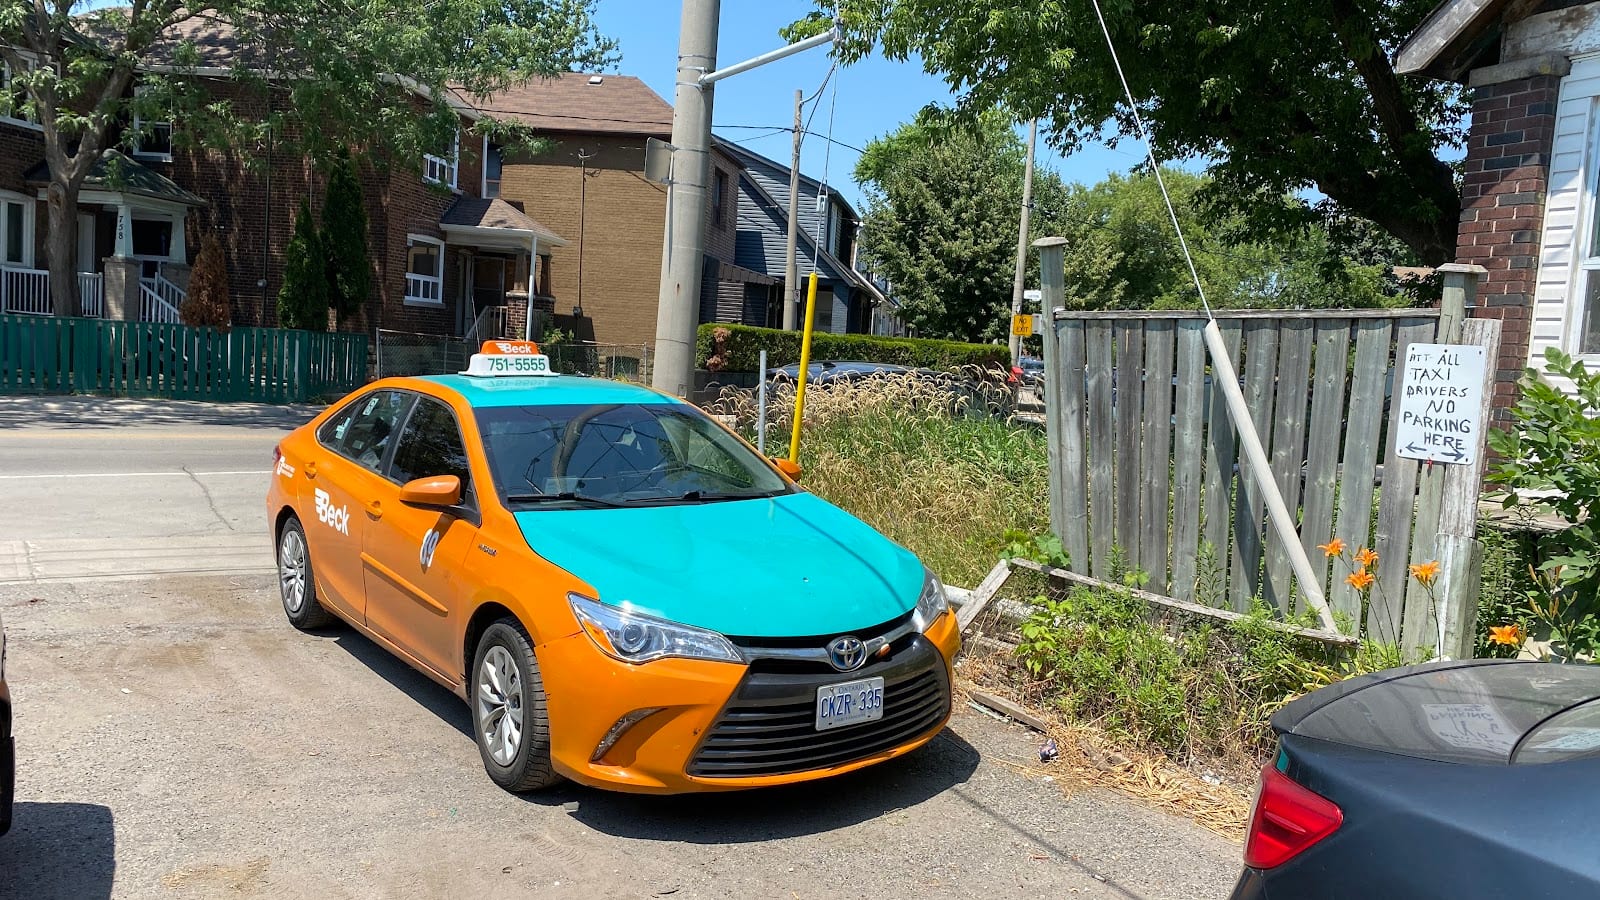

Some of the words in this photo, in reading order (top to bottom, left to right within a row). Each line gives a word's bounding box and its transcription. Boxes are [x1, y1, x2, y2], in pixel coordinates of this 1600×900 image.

[496, 343, 532, 354] Beck
[487, 358, 546, 371] 751-5555
[1437, 354, 1460, 366] ALL
[1411, 368, 1451, 383] TAXI
[1406, 385, 1469, 398] DRIVERS
[1426, 400, 1455, 416] NO
[1403, 411, 1472, 433] PARKING
[1424, 432, 1466, 450] HERE
[314, 487, 350, 537] Beck
[821, 692, 852, 718] CKZR
[858, 687, 882, 711] 335
